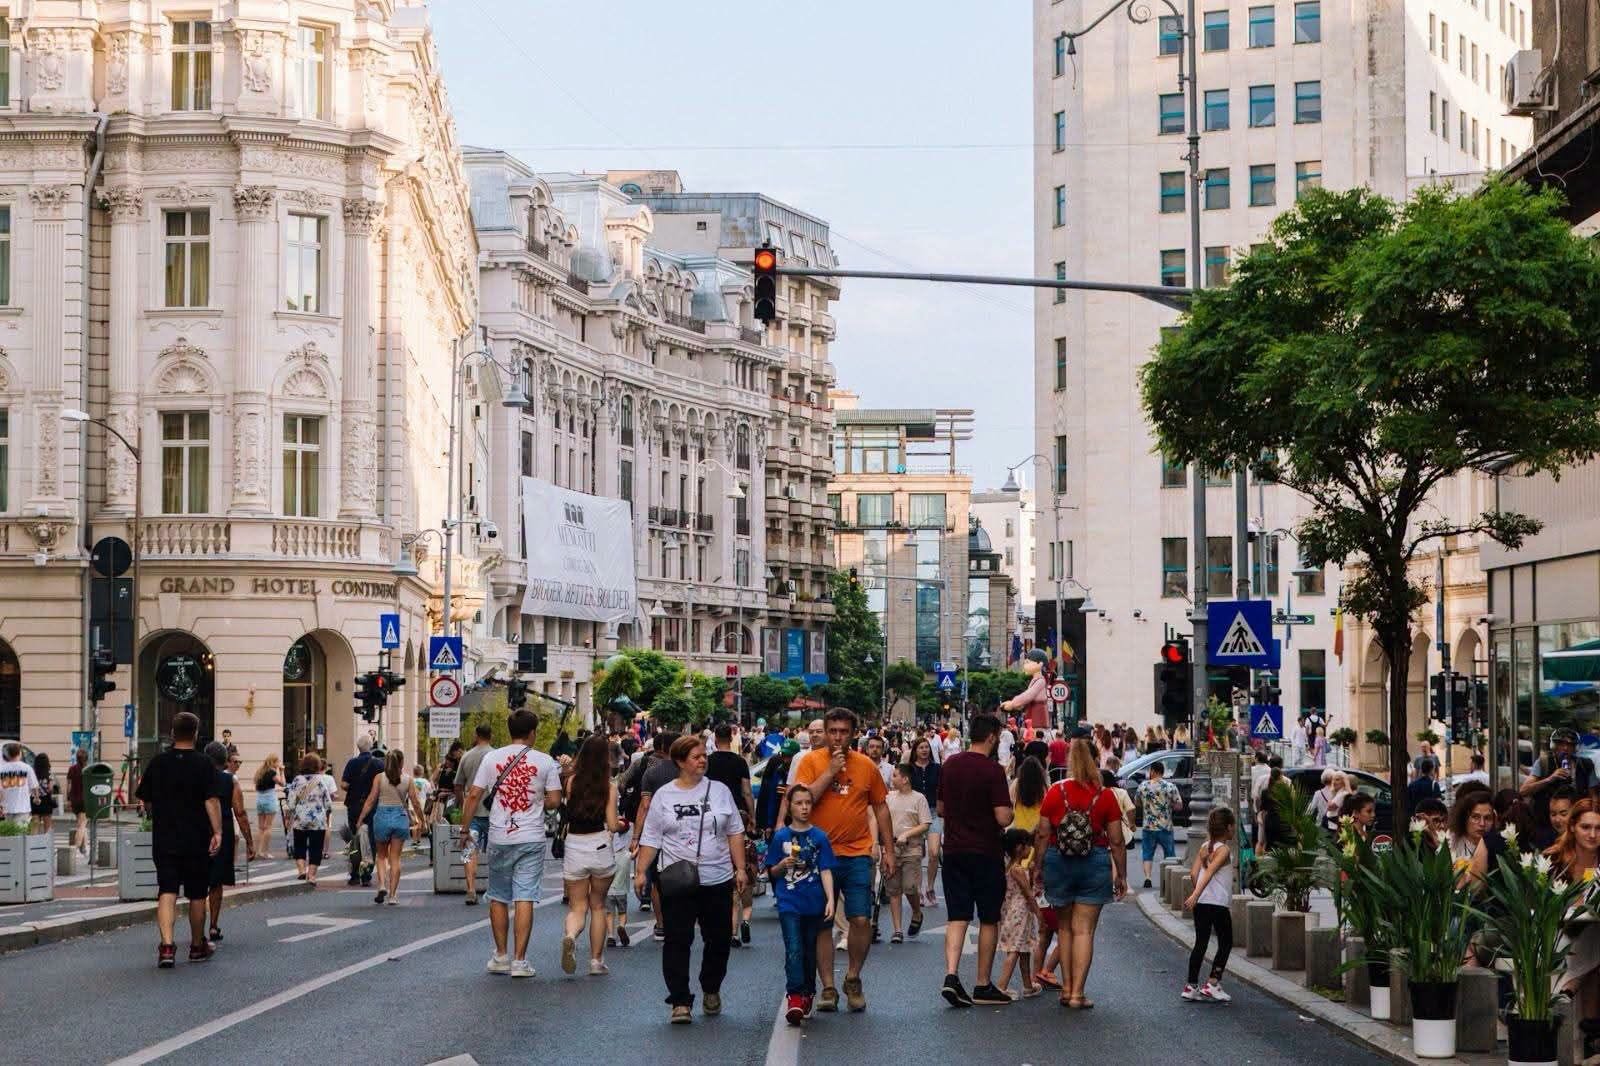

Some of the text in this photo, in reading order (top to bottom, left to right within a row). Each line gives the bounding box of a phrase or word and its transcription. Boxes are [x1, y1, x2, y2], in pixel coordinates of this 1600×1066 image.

[160, 577, 235, 593] GRAND
[253, 578, 321, 594] HOTEL
[1054, 687, 1066, 697] 30
